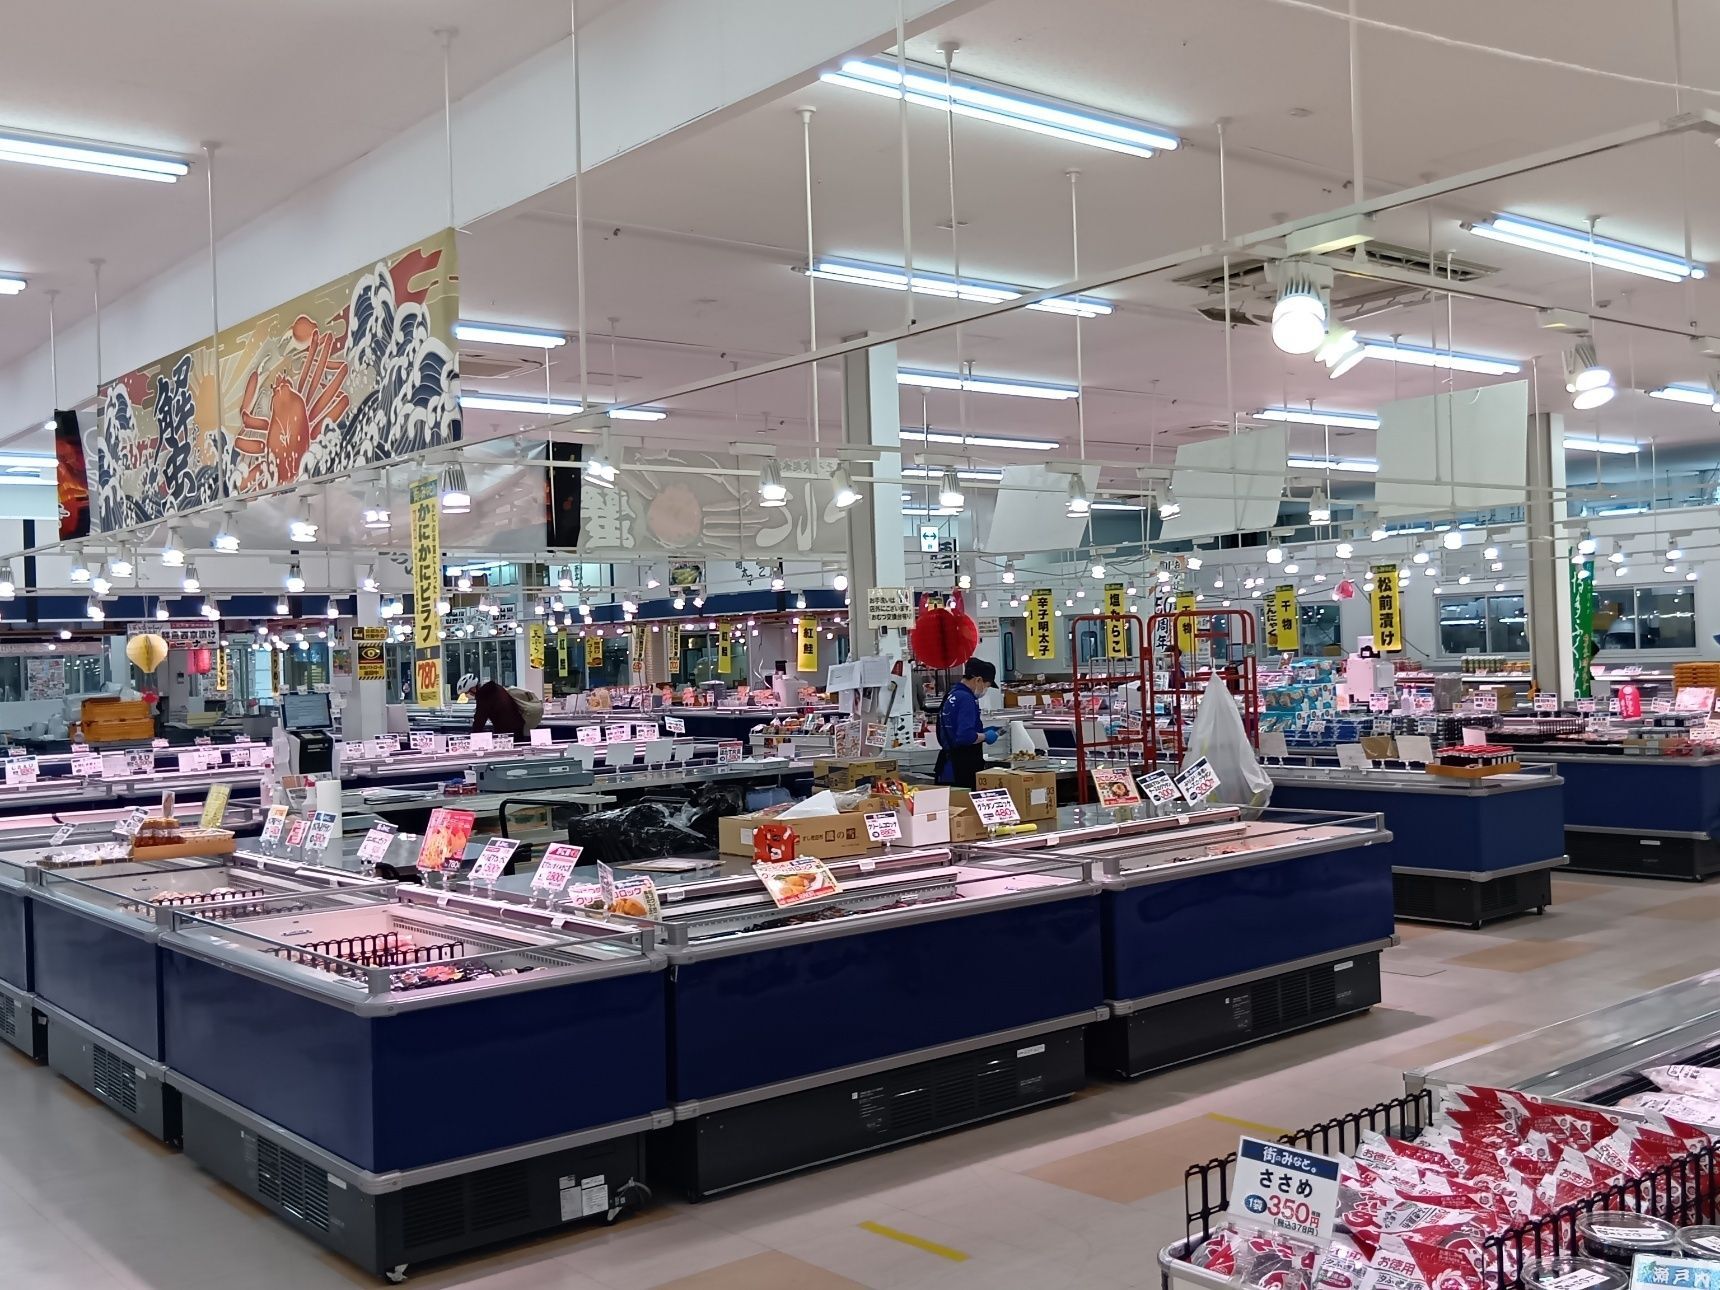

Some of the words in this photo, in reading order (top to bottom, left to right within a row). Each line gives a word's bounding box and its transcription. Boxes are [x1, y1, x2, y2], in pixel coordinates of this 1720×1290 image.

[417, 503, 433, 643] かにかにピラフ
[1037, 597, 1050, 657] 辛子明太子
[1109, 593, 1121, 654] 塩たらこ
[1281, 601, 1292, 631] 干物
[1377, 577, 1395, 646] 松前漬け
[803, 628, 814, 655] 紅鮭
[1259, 1168, 1313, 1199] ささめ
[1377, 1256, 1416, 1277] お徳用
